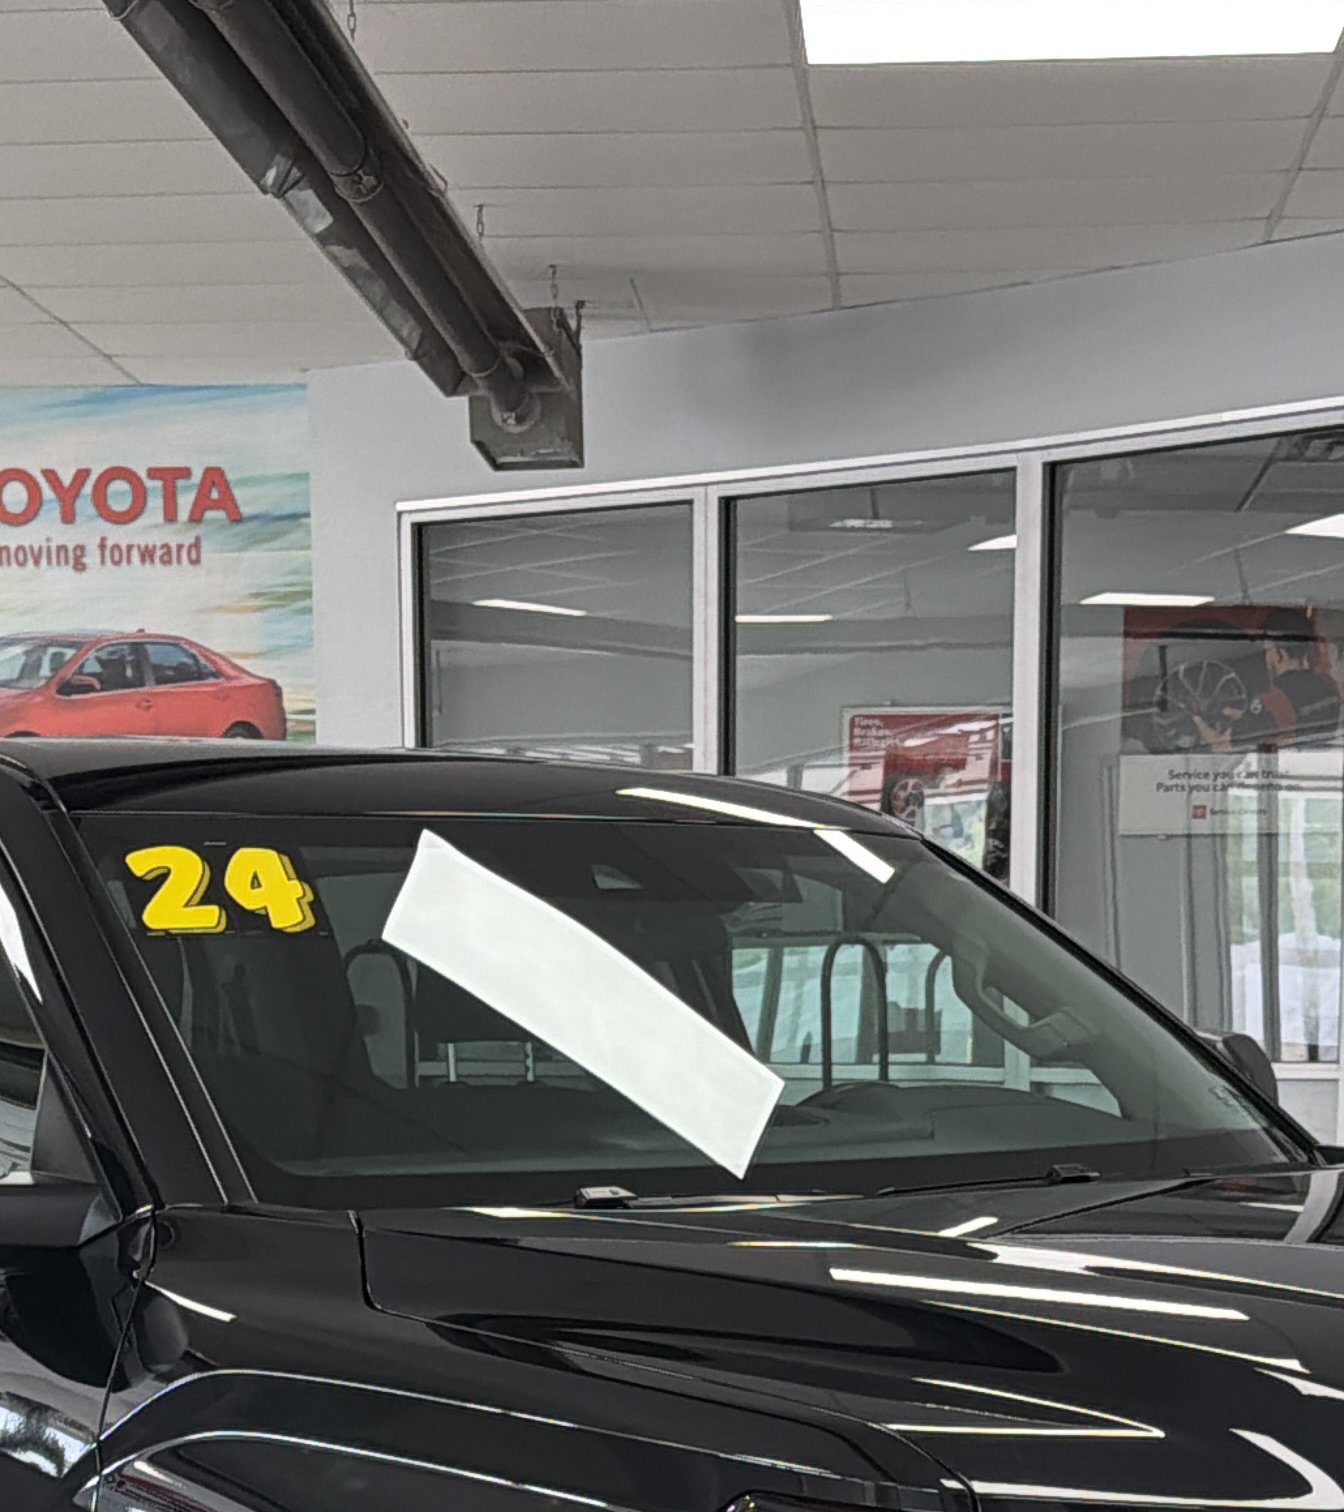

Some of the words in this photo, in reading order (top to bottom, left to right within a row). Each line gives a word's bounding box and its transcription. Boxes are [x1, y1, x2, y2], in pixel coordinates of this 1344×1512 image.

[97, 535, 203, 567] forward
[1167, 769, 1209, 780] Service
[1156, 782, 1186, 793] Parts
[1188, 783, 1210, 795] you
[124, 846, 317, 934] 24
